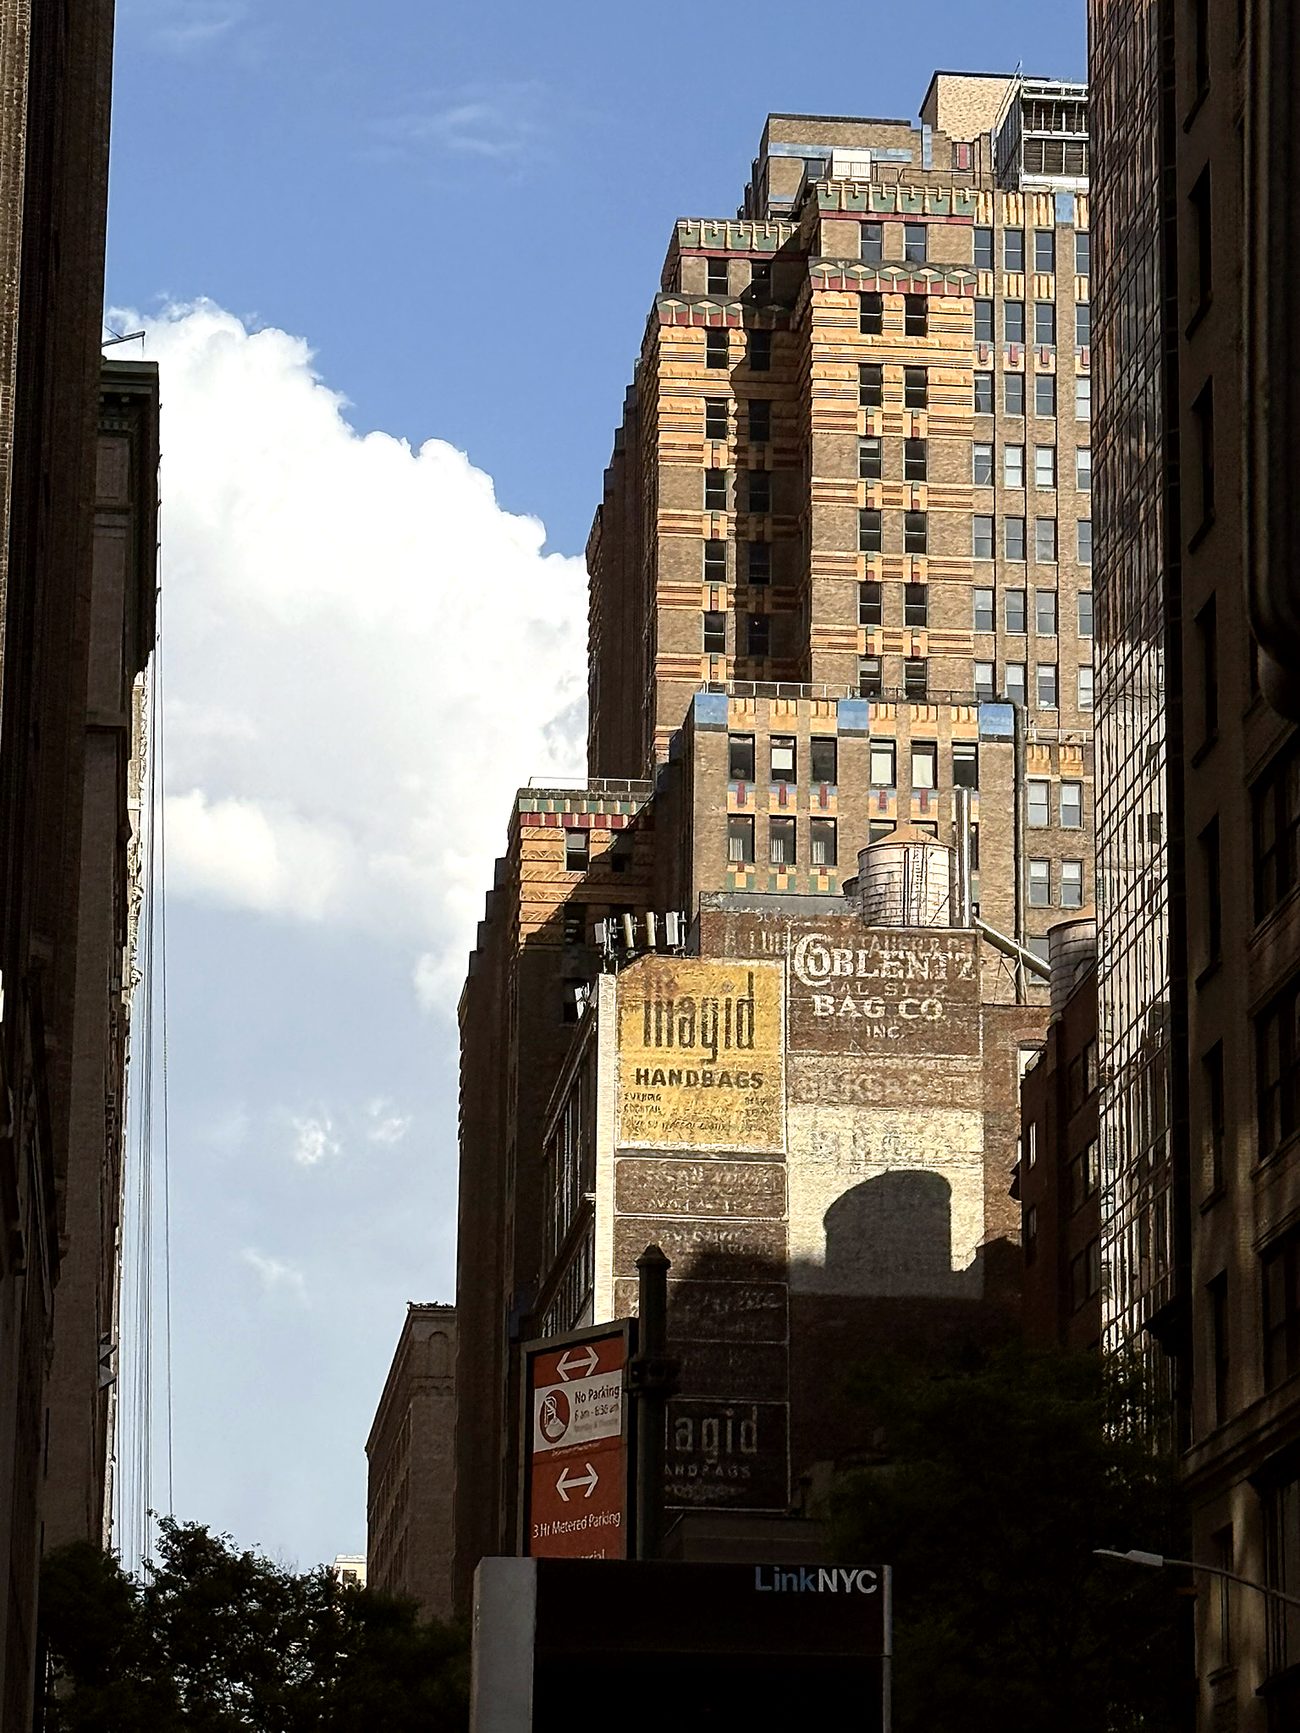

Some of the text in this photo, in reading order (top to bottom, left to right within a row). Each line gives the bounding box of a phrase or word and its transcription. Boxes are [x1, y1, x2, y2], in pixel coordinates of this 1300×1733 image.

[812, 994, 886, 1019] BAG
[635, 1067, 764, 1090] HANDBAGS
[574, 1384, 620, 1404] No Parking
[533, 1524, 539, 1539] 3
[551, 1515, 587, 1534] Metered
[588, 1511, 621, 1528] Parking
[755, 1566, 878, 1594] LinkNYC
